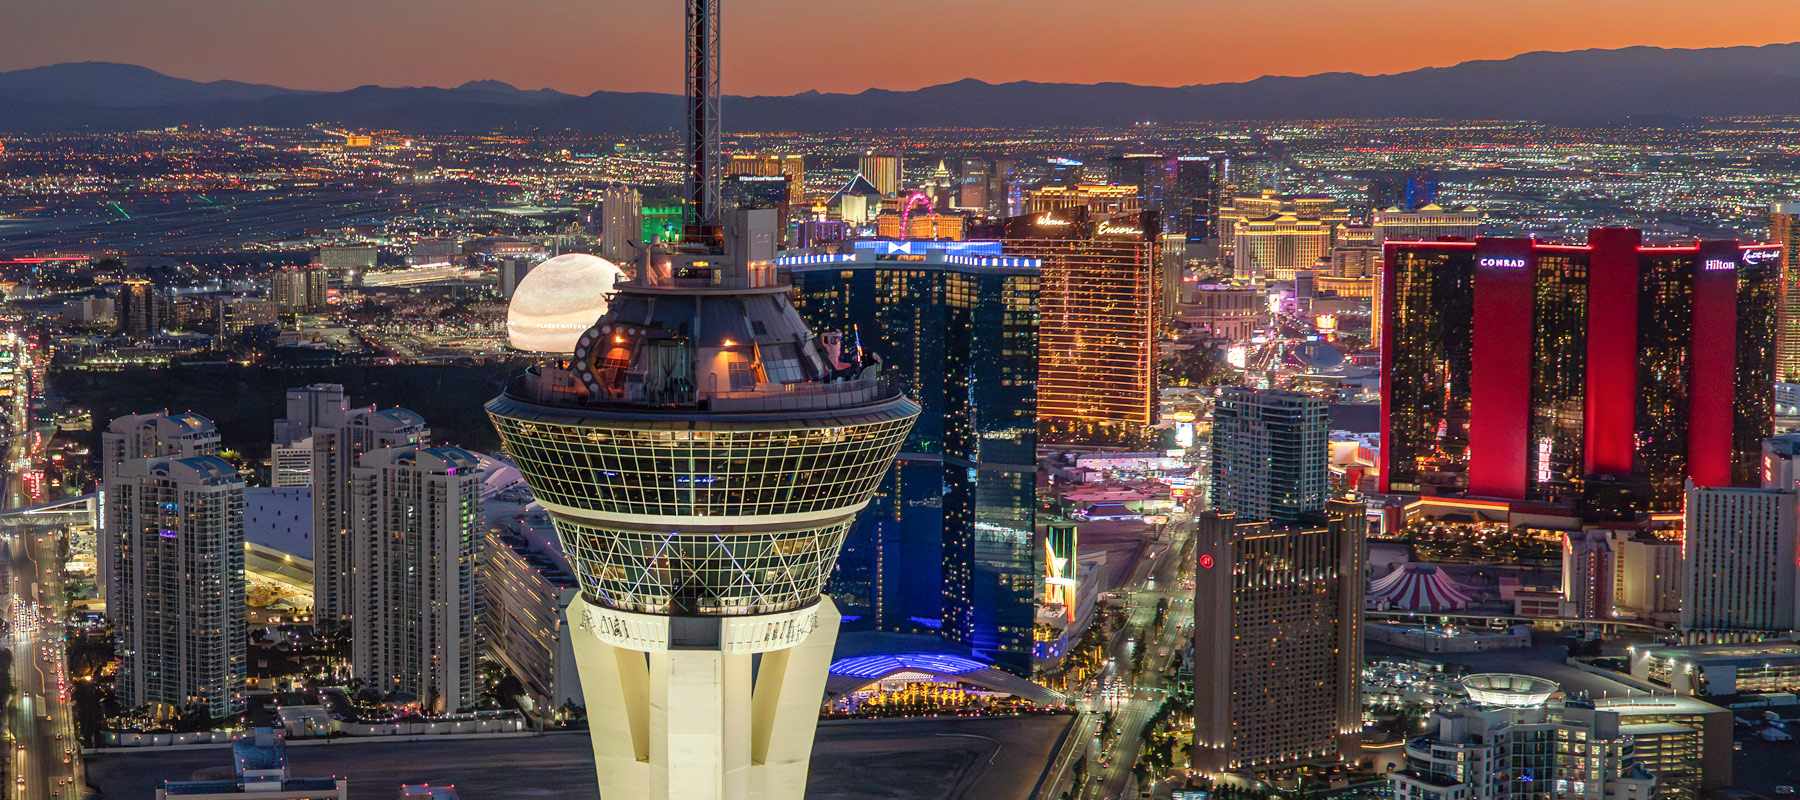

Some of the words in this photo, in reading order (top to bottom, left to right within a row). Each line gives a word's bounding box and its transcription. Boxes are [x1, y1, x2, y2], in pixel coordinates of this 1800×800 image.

[1098, 220, 1143, 235] Encore
[1480, 258, 1525, 267] CONRAD
[1705, 259, 1735, 270] Hilton
